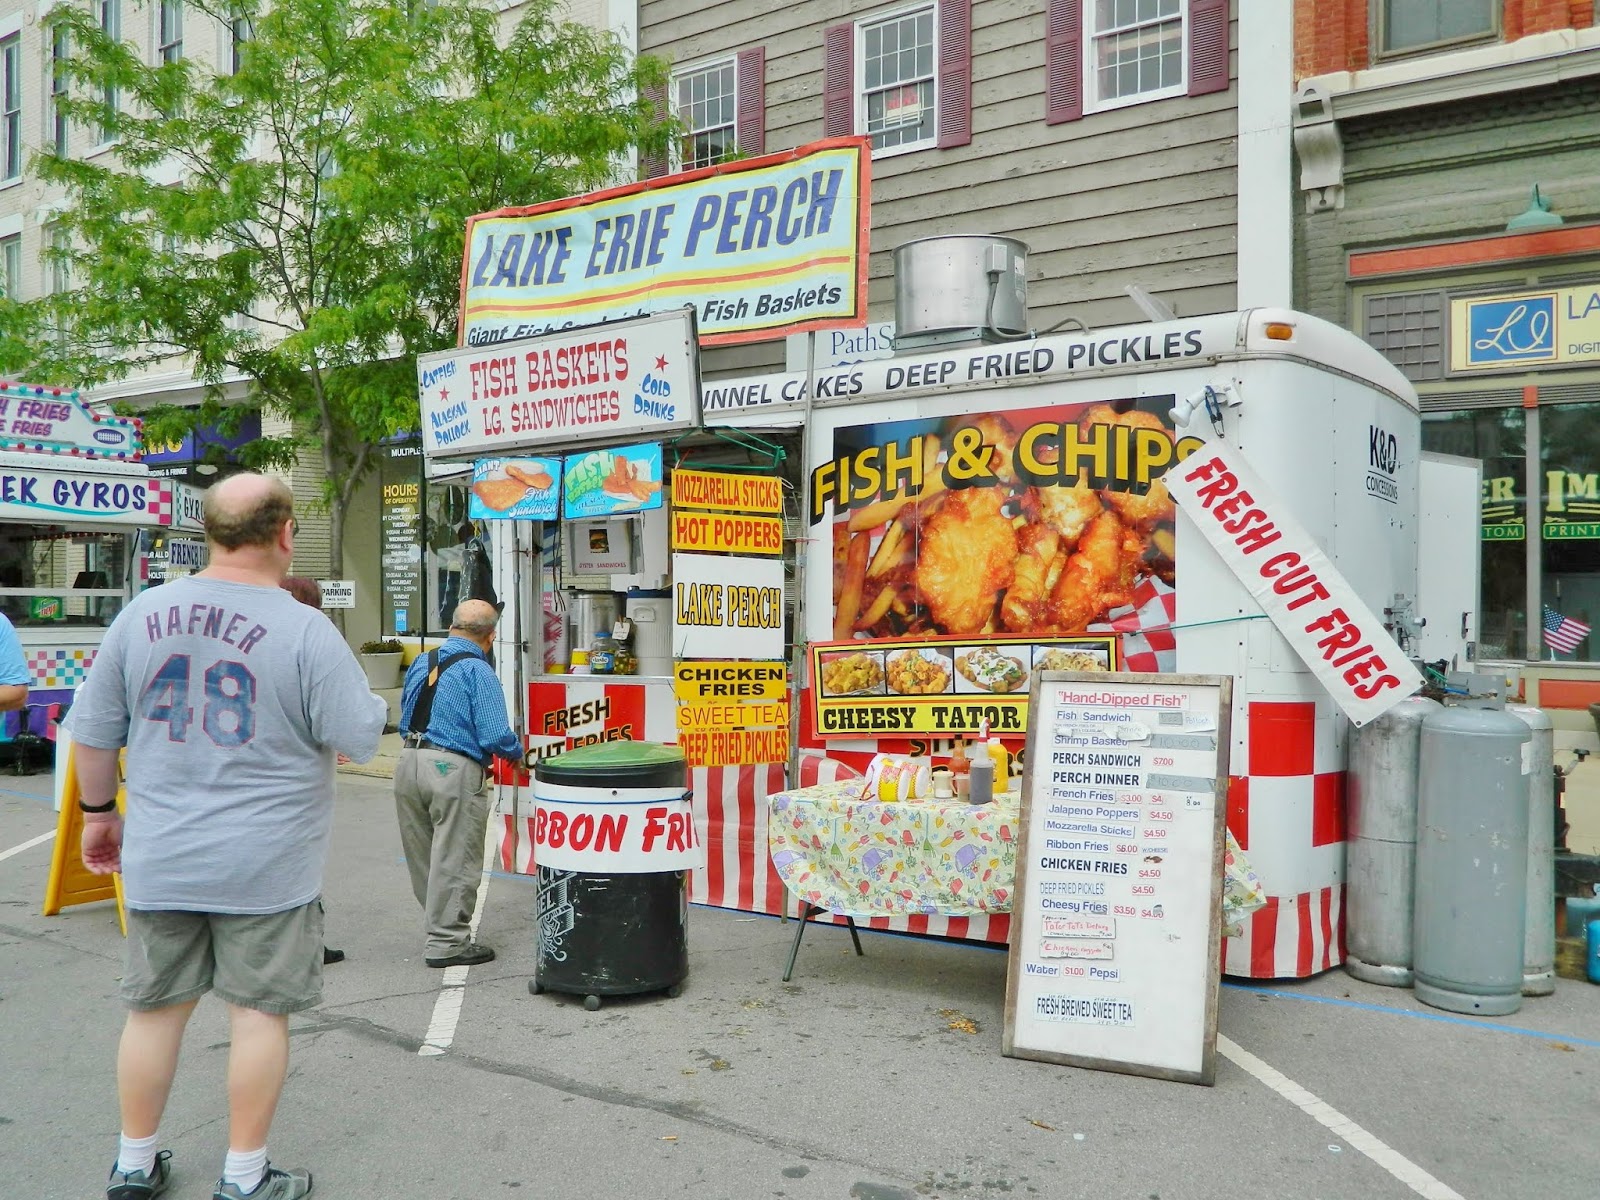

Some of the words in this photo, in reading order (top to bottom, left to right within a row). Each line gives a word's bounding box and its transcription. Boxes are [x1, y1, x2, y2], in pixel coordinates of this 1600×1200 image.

[473, 226, 572, 288] LAKE
[585, 204, 676, 278] ERIE
[684, 169, 844, 258] PERCH
[702, 299, 748, 322] Fish
[755, 283, 841, 317] Baskets
[468, 325, 508, 345] Giant
[470, 356, 518, 400] FISH
[526, 339, 629, 393] BASKETS
[885, 360, 957, 392] DEEP
[968, 348, 1054, 380] FRIED
[1068, 329, 1203, 370] PICKLES
[422, 359, 457, 388] CATFISH
[642, 374, 671, 397] COLD
[17, 401, 72, 421] FRIES
[431, 400, 468, 430] ALASKAN
[482, 406, 505, 436] LG.
[511, 390, 620, 432] SANDWICHES
[634, 394, 675, 421] DRINKS
[12, 420, 53, 436] FRIES
[434, 419, 471, 448] POLLOCK
[1370, 425, 1397, 474] K&D
[474, 461, 500, 476] GIANT
[812, 433, 926, 514] FISH
[947, 426, 994, 483] &
[53, 479, 146, 511] GYROS
[383, 483, 418, 497] HOURS
[524, 487, 550, 503] Fish
[675, 474, 740, 506] MOZZARELLA
[742, 479, 779, 509] STICKS
[1366, 474, 1398, 499] CONCESSIONS
[508, 501, 558, 518] Sandwich
[1184, 456, 1282, 555] FRESH
[676, 518, 709, 545] HOT
[714, 519, 780, 548] POPPERS
[1485, 527, 1519, 537] TOM
[1549, 525, 1600, 535] PRINT
[322, 588, 352, 596] PARKING
[1260, 552, 1331, 611] CUT
[677, 582, 723, 627] LAKE
[727, 585, 781, 629] PERCH
[146, 604, 268, 655] HAFNER
[1304, 607, 1401, 700] FRIES
[678, 668, 783, 681] CHICKEN
[141, 653, 257, 748] 48
[699, 683, 765, 697] FRIES
[544, 696, 611, 735] FRESH
[680, 706, 746, 726] SWEET
[751, 705, 785, 723] TEA
[823, 707, 916, 729] CHEESY
[932, 706, 1021, 729] TATOR
[1056, 710, 1077, 720] Fish
[1083, 712, 1131, 722] Sandwich
[679, 732, 708, 766] DEEP
[712, 731, 741, 764] FRIED
[745, 730, 787, 763] PICKLES
[1054, 736, 1089, 747] Shrimp
[1052, 752, 1085, 765] PERCH
[1088, 753, 1141, 767] SANDWICH
[1053, 772, 1090, 784] PERCH
[1095, 773, 1139, 786] DINNER
[1052, 788, 1086, 799] French
[1089, 790, 1114, 801] Fries
[1048, 804, 1093, 816] Jalapeno
[1096, 807, 1138, 819] Poppers
[1150, 811, 1172, 820] $4.50
[1046, 821, 1097, 832] Mozzarella
[1100, 825, 1132, 836] Sticks
[1144, 829, 1166, 837] $4.50
[1046, 839, 1081, 849] Ribbon
[1084, 841, 1109, 851] Fries
[1041, 857, 1091, 871] CHICKEN
[1095, 860, 1128, 875] FRIES
[1139, 869, 1161, 878] $4.50
[1040, 882, 1056, 894] DEEP
[1058, 882, 1076, 894] FRIED
[1077, 883, 1104, 895] PICKLES
[1132, 886, 1154, 894] $4.50
[1042, 899, 1080, 912] Cheesy
[1083, 901, 1108, 912] Fries
[1114, 905, 1136, 915] $3.50
[1141, 909, 1164, 918] $4.0
[1026, 964, 1058, 975] Water
[1065, 967, 1084, 976] $1.00
[1090, 967, 1118, 980] Pepsi
[1037, 998, 1060, 1014] FRESH
[1061, 999, 1091, 1017] BREWED
[1092, 1001, 1117, 1019] SWEET
[1118, 1003, 1133, 1021] TEA
